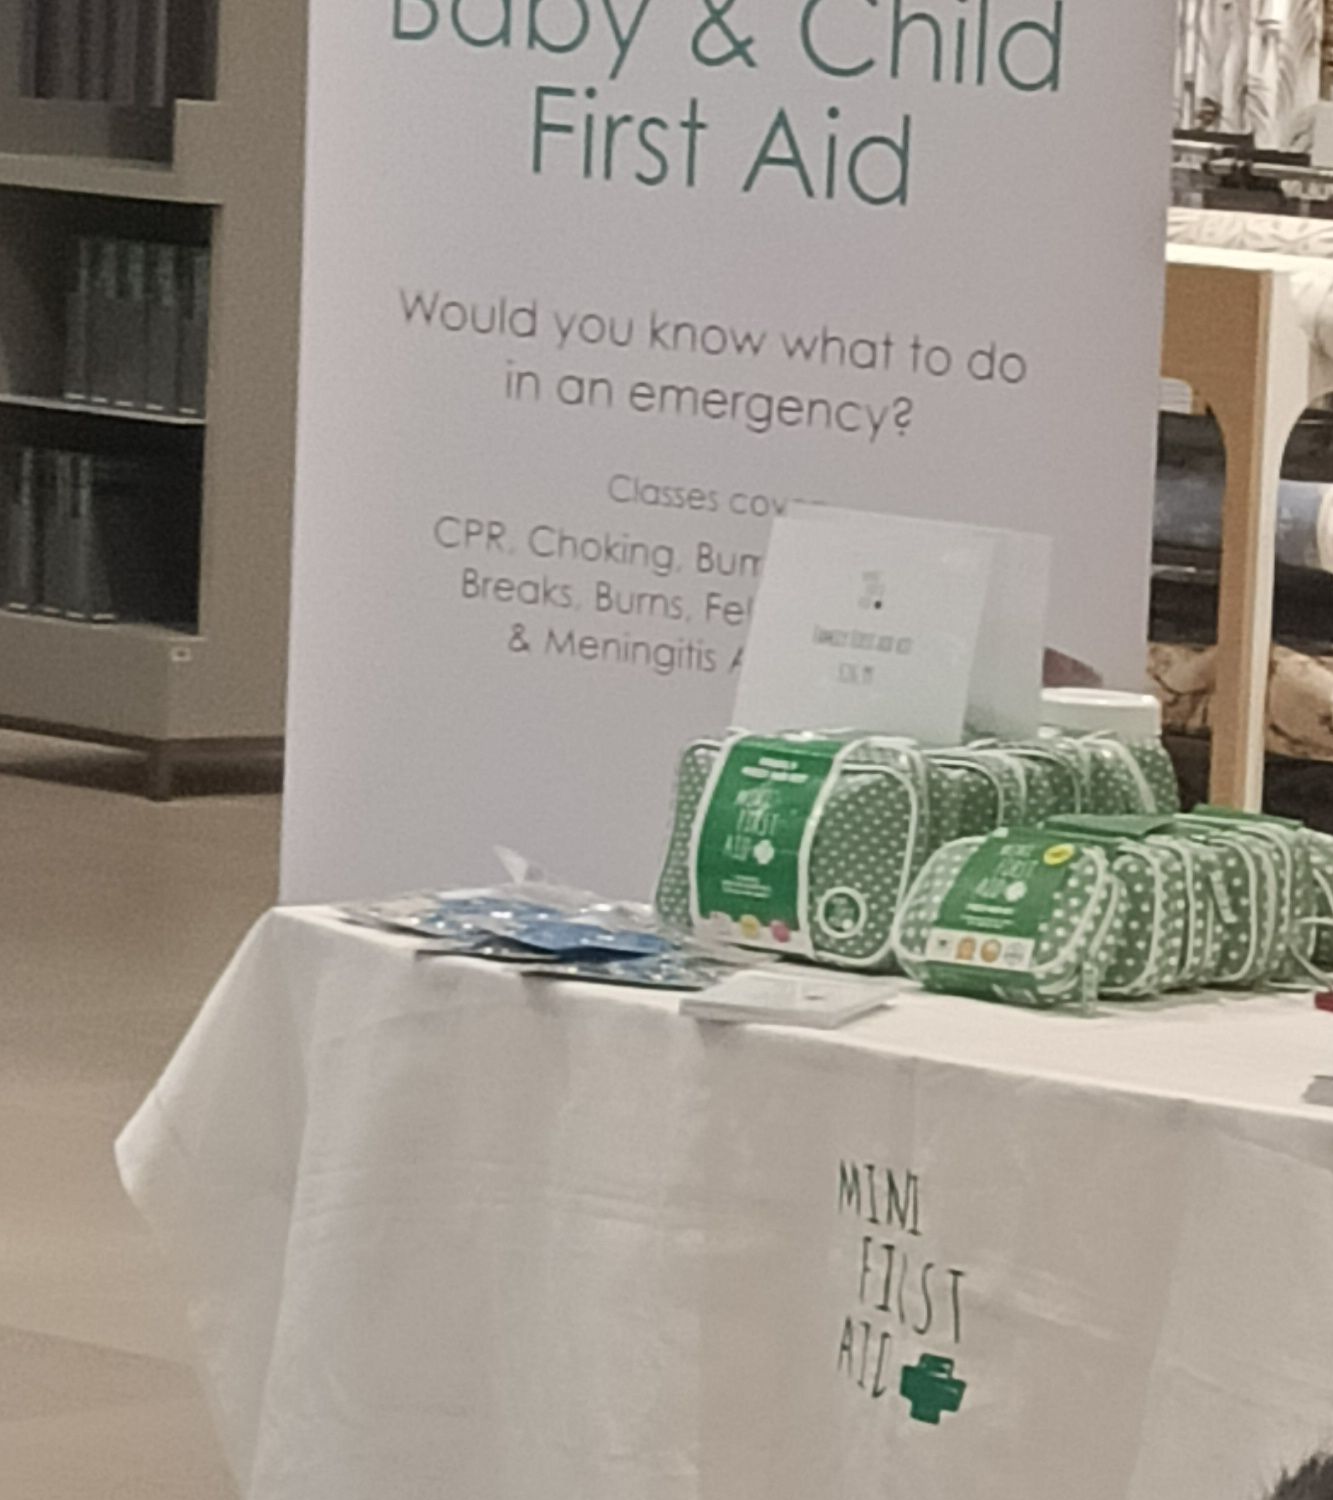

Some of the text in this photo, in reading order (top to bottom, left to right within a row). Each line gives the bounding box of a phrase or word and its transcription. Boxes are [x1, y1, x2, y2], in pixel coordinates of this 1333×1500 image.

[691, 0, 757, 68] &
[800, 0, 1063, 92] Child
[532, 86, 911, 206] First Aid
[400, 290, 1027, 384] Would you know what to do
[505, 358, 914, 444] in an emergency?
[608, 473, 719, 513] Classes
[433, 515, 515, 556] CPR,
[527, 525, 683, 578] Choking,
[461, 567, 582, 611] Breaks,
[594, 580, 691, 624] Burns,
[508, 622, 530, 653] &
[544, 629, 717, 676] Meningitis
[837, 1159, 922, 1237] MINI
